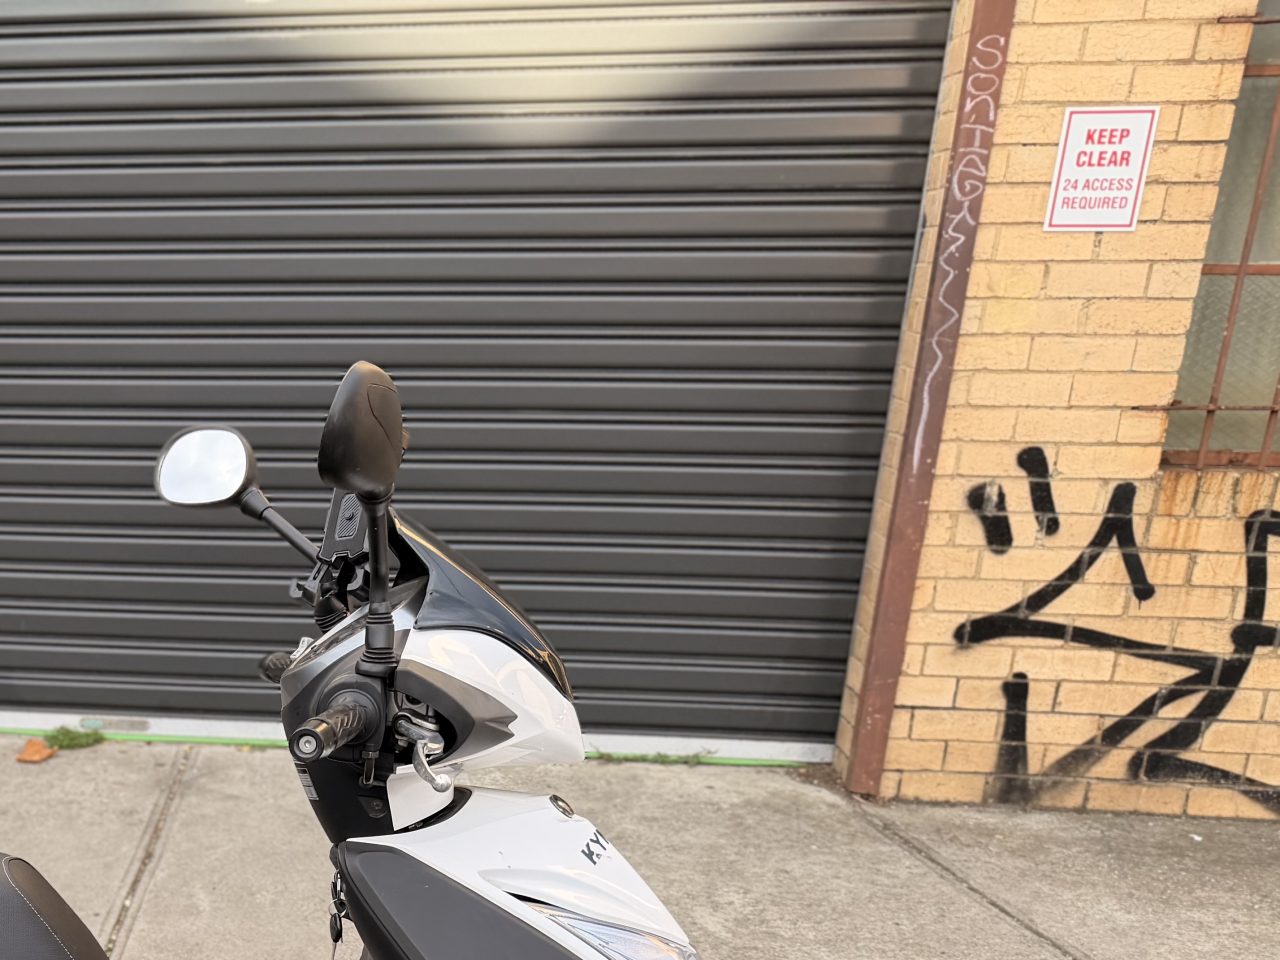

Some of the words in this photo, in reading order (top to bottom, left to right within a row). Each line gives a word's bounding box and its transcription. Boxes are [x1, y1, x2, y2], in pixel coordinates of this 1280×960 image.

[1085, 128, 1131, 146] KEEP
[1075, 150, 1132, 168] CLEAR
[1062, 178, 1079, 192] 24
[1081, 177, 1134, 191] ACCESS
[1061, 196, 1129, 210] REQUIRED
